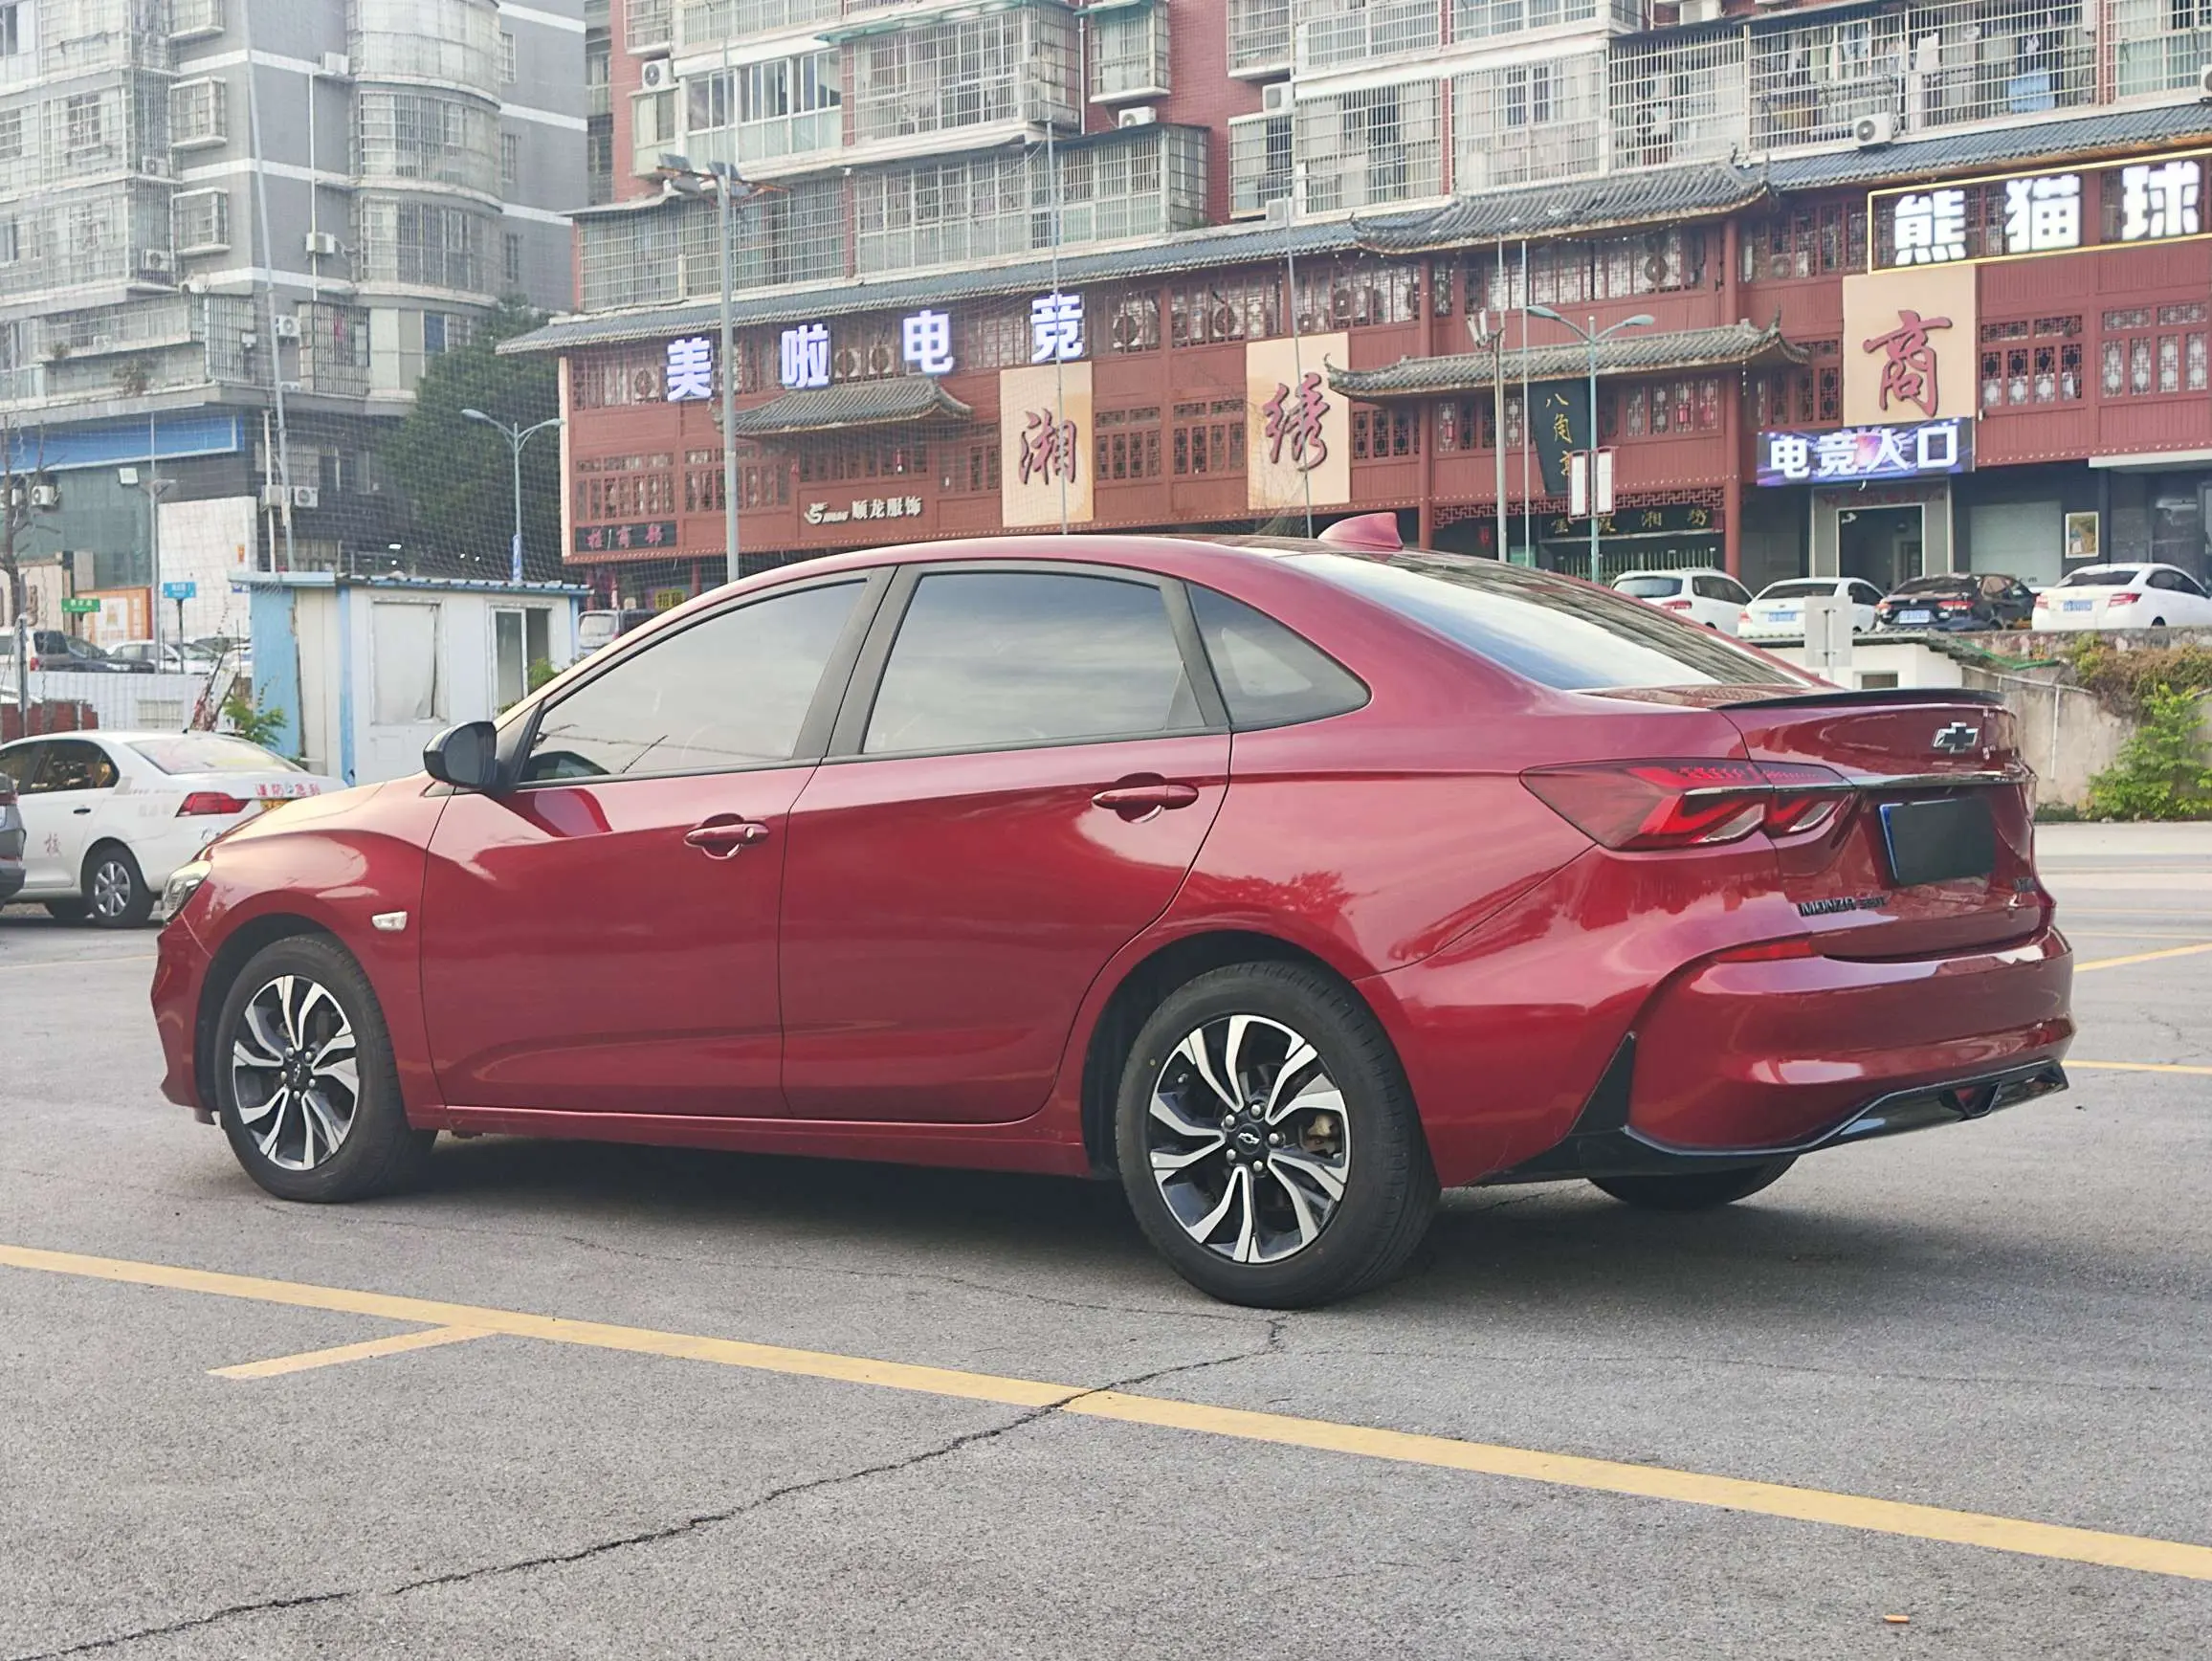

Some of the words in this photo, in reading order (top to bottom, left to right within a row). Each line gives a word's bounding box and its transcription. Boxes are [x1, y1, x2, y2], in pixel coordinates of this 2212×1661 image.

[1894, 161, 2201, 266] 熊猫球
[666, 291, 1085, 402] 美啦电竞
[1863, 309, 1953, 418] 商
[1019, 409, 1077, 486] 湘
[1262, 372, 1331, 472] 绣
[1769, 422, 1959, 479] 电竞入口
[852, 496, 922, 520] 顺龙服饰
[1799, 896, 1856, 917] MONZA
